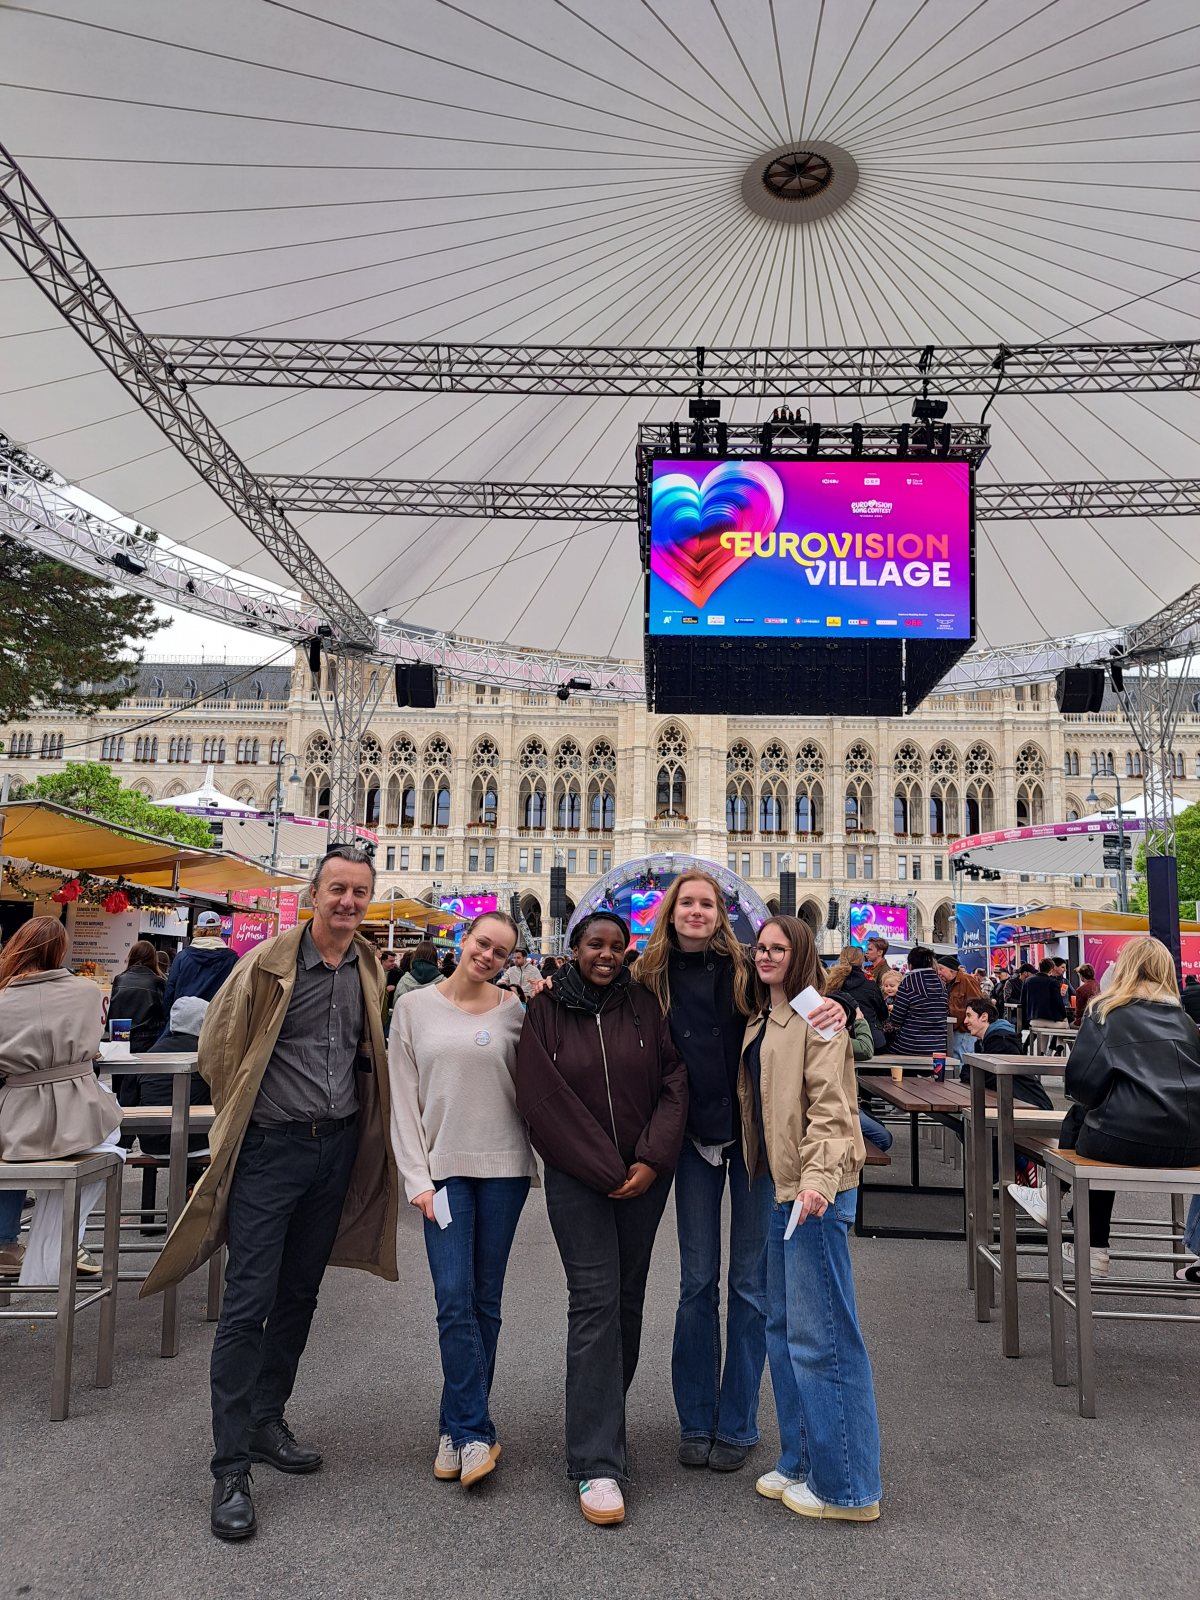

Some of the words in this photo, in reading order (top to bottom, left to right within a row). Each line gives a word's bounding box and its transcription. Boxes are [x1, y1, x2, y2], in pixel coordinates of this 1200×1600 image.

[720, 532, 949, 566] EUROVISION
[804, 560, 951, 588] VILLAGE
[150, 911, 166, 928] PACO
[240, 923, 262, 932] United
[236, 932, 243, 942] by
[245, 932, 264, 941] Music
[1181, 961, 1192, 969] My
